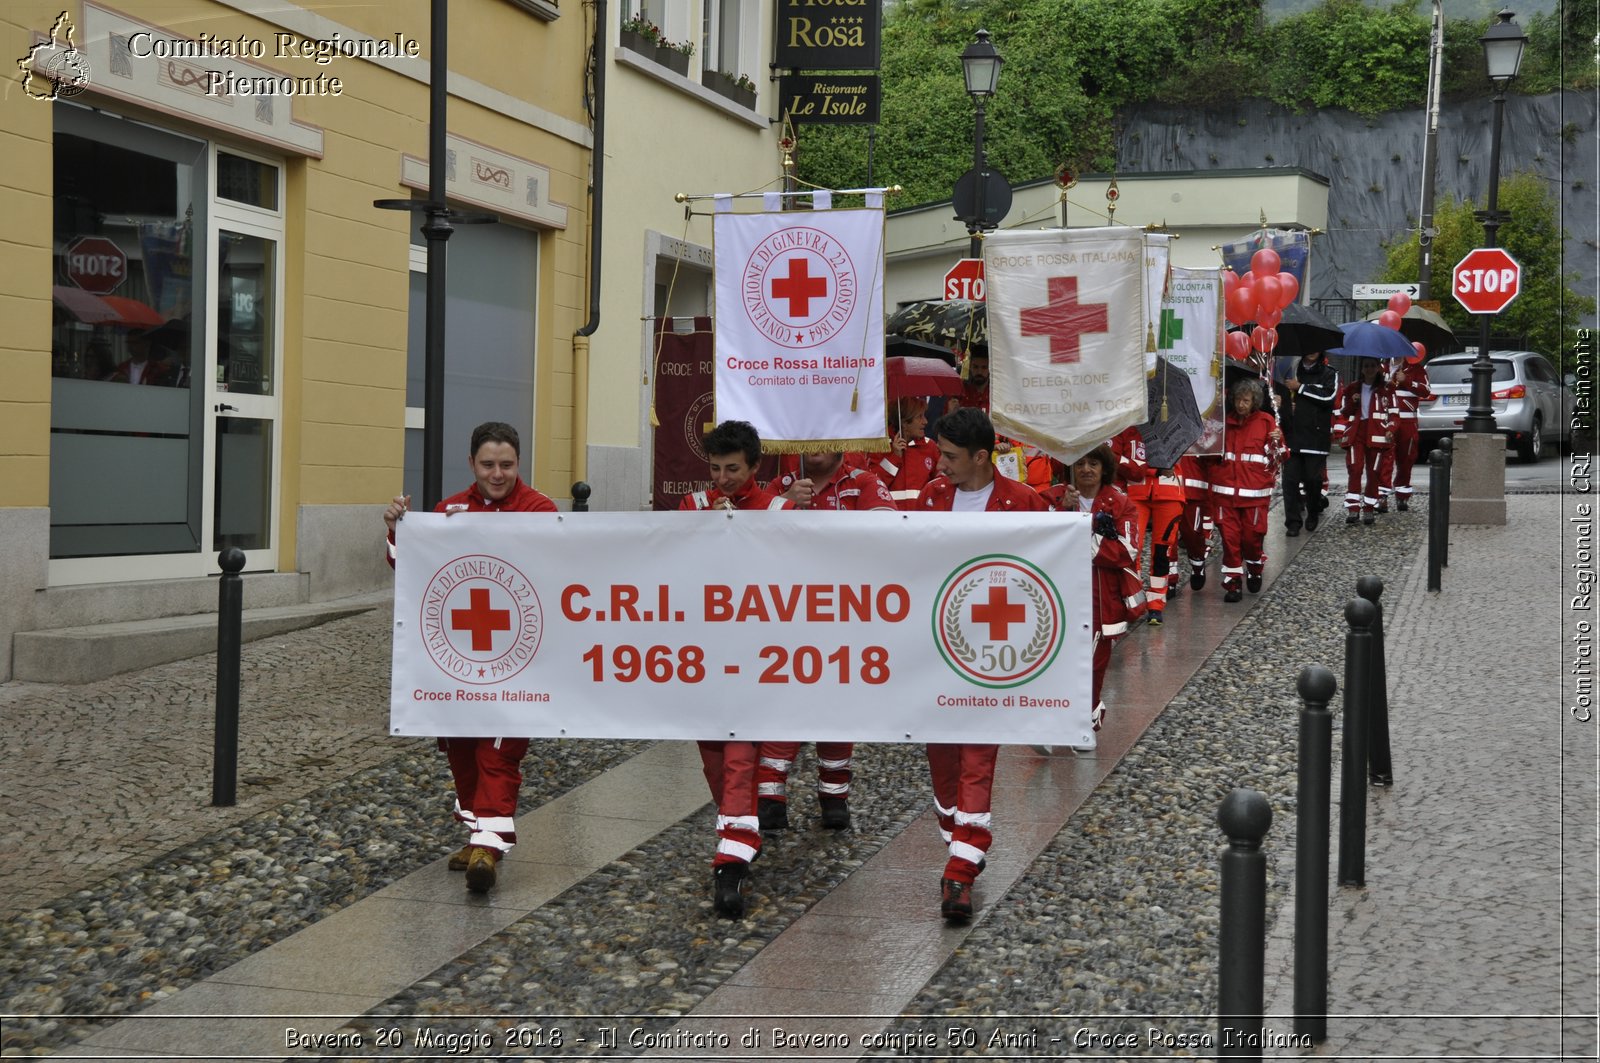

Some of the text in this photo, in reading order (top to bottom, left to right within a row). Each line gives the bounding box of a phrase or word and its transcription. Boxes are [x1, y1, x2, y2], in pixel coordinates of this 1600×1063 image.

[787, 17, 865, 47] Rosa
[813, 83, 867, 94] Ristorante
[789, 95, 867, 115] Le Isole
[698, 249, 712, 264] ROS
[992, 255, 1033, 269] CROCE
[1037, 253, 1077, 265] ROSSA
[1081, 251, 1135, 264] ITALIANA
[746, 231, 853, 343] CONVENZIONE DI GINEVRA 22 AGOSTO 1864
[947, 278, 985, 300] STO
[1458, 268, 1515, 293] STOP
[235, 292, 253, 313] LPG
[661, 361, 713, 376] CROCE RO
[726, 356, 875, 370] Croce Rossa Italiana
[748, 374, 855, 386] Comitato di Baveno
[1022, 373, 1109, 388] DELEGAZIONE
[1060, 389, 1072, 399] DI
[1004, 398, 1132, 415] GRAVELLONA TOCE
[560, 583, 911, 623] C.R.I. BAVENO
[426, 560, 538, 678] CONVENZIONE DI GINEVRA 22 AGOSTO 1864
[582, 644, 891, 685] 1968 - 2018
[979, 644, 1017, 672] 50
[413, 689, 550, 703] Croce Rossa Italiana
[937, 694, 1070, 708] Comitato di Baveno
